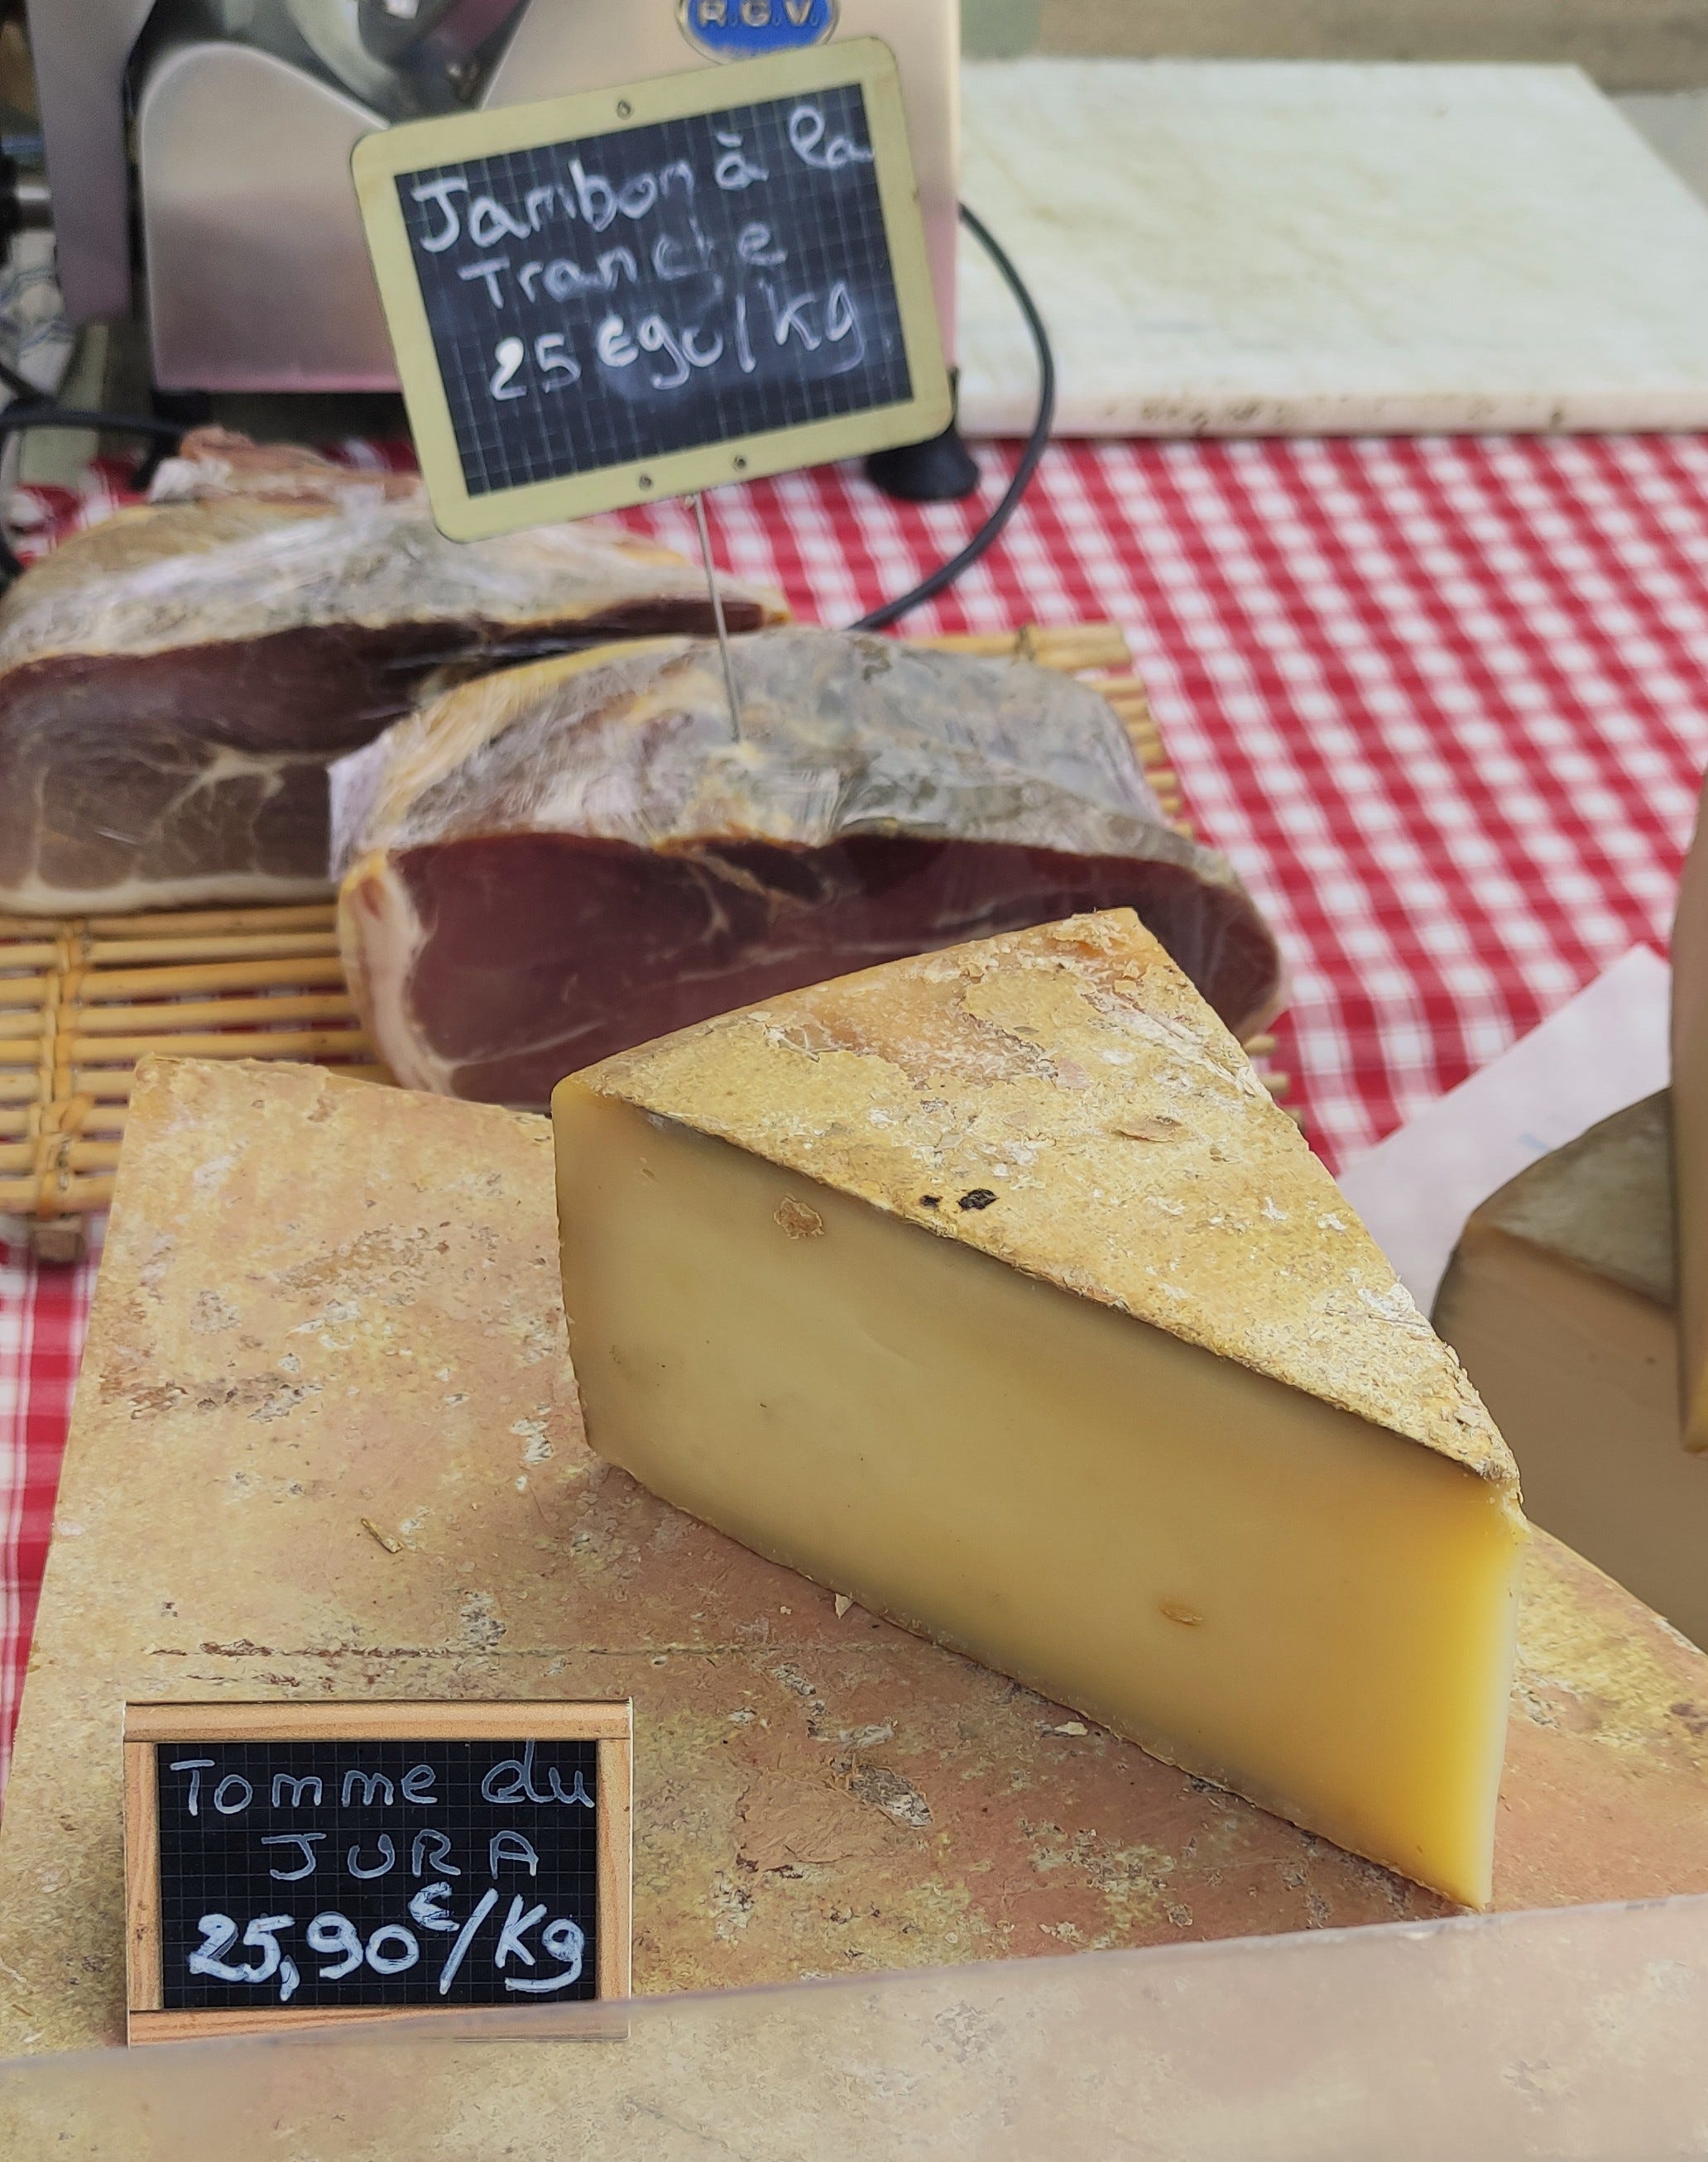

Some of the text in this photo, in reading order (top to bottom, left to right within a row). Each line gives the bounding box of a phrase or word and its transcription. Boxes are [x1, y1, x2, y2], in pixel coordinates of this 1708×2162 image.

[411, 104, 875, 252] Jambon à la
[457, 217, 787, 309] Tranche
[169, 1738, 595, 1816] Tomme du
[261, 1828, 540, 1881] JURA
